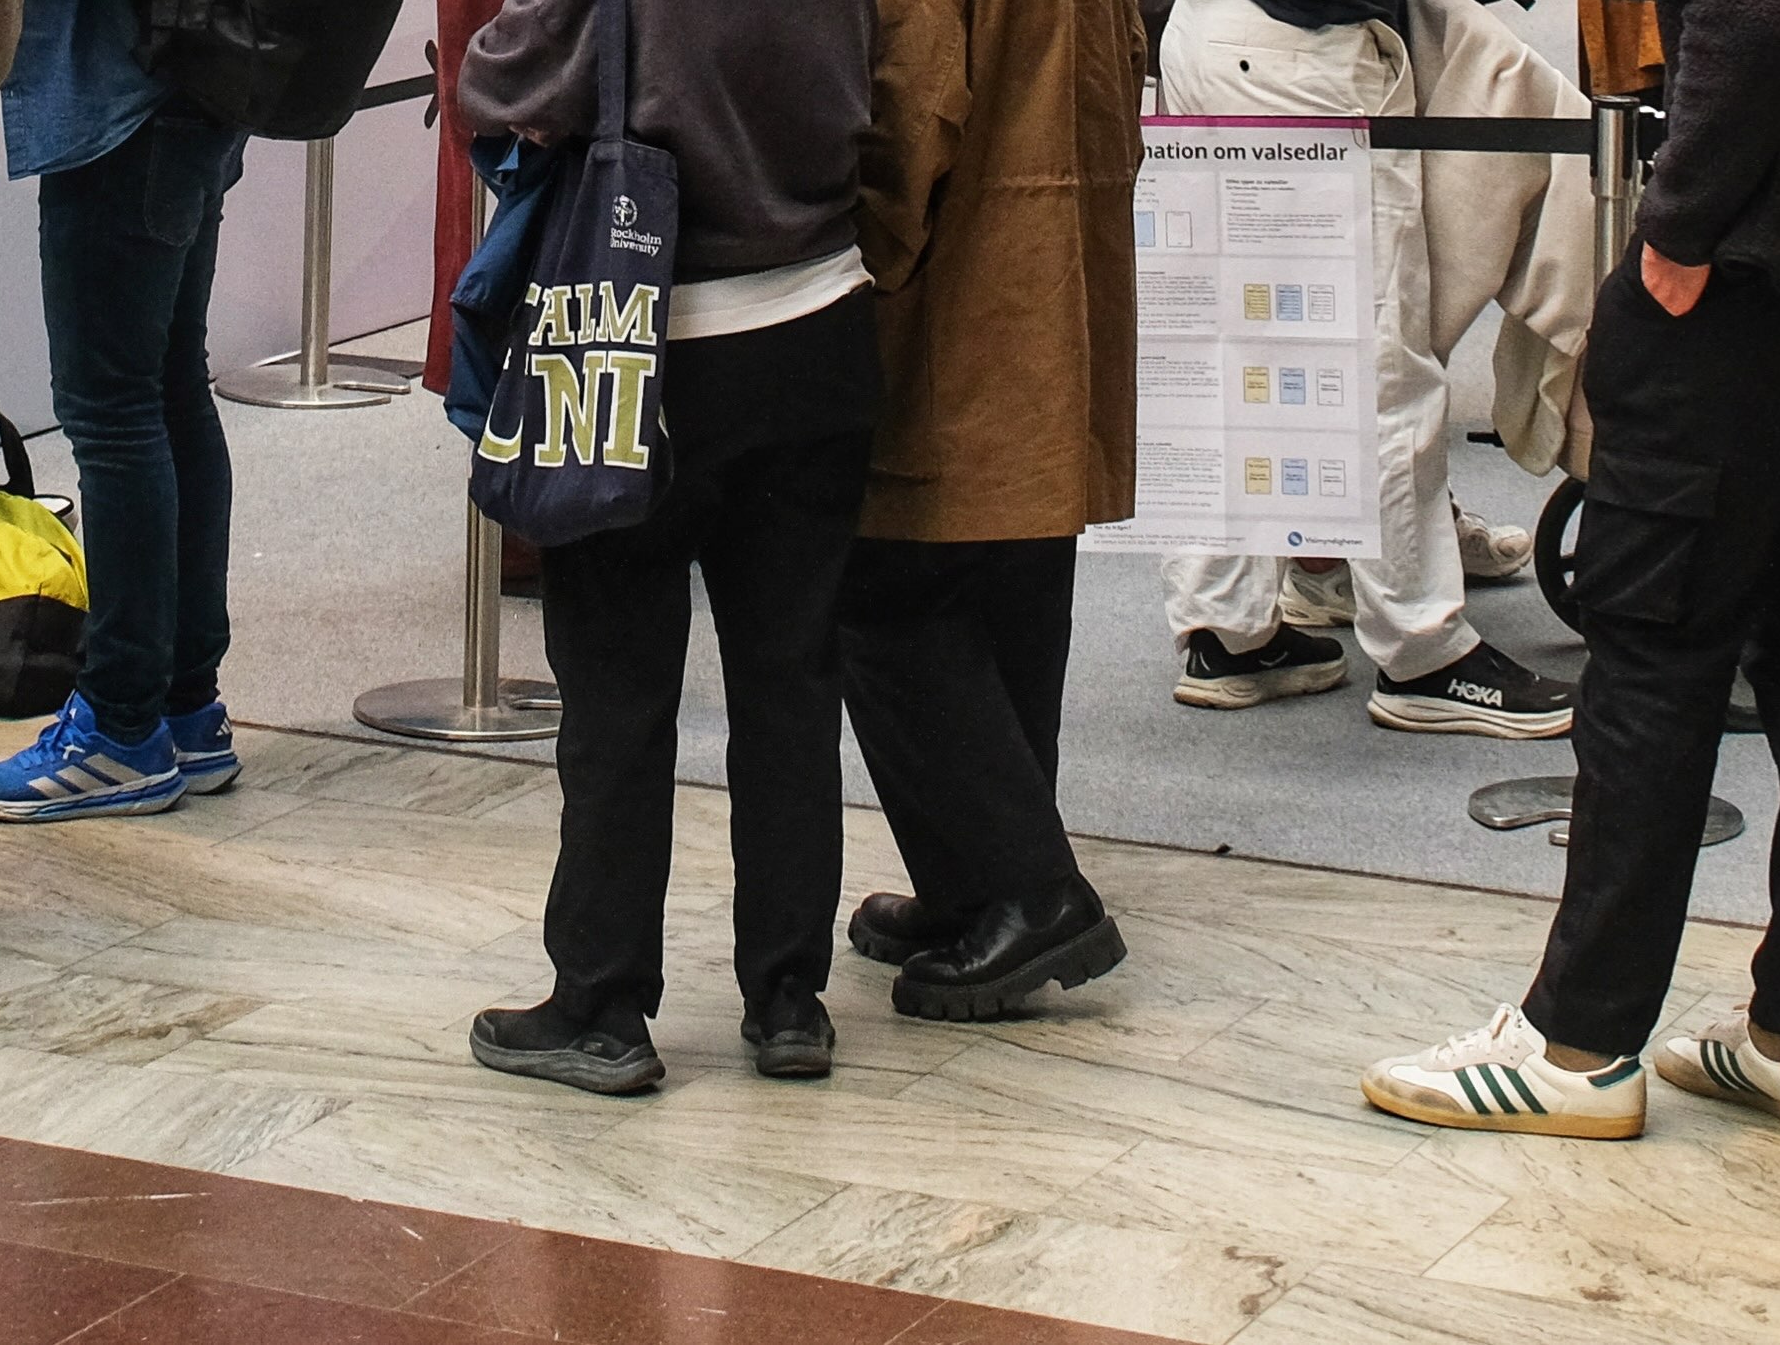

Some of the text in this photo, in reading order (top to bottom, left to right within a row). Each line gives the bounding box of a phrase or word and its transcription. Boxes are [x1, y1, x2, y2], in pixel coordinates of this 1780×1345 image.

[1213, 145, 1246, 160] om
[1252, 143, 1348, 161] valsedlar
[1448, 678, 1502, 707] HOKA
